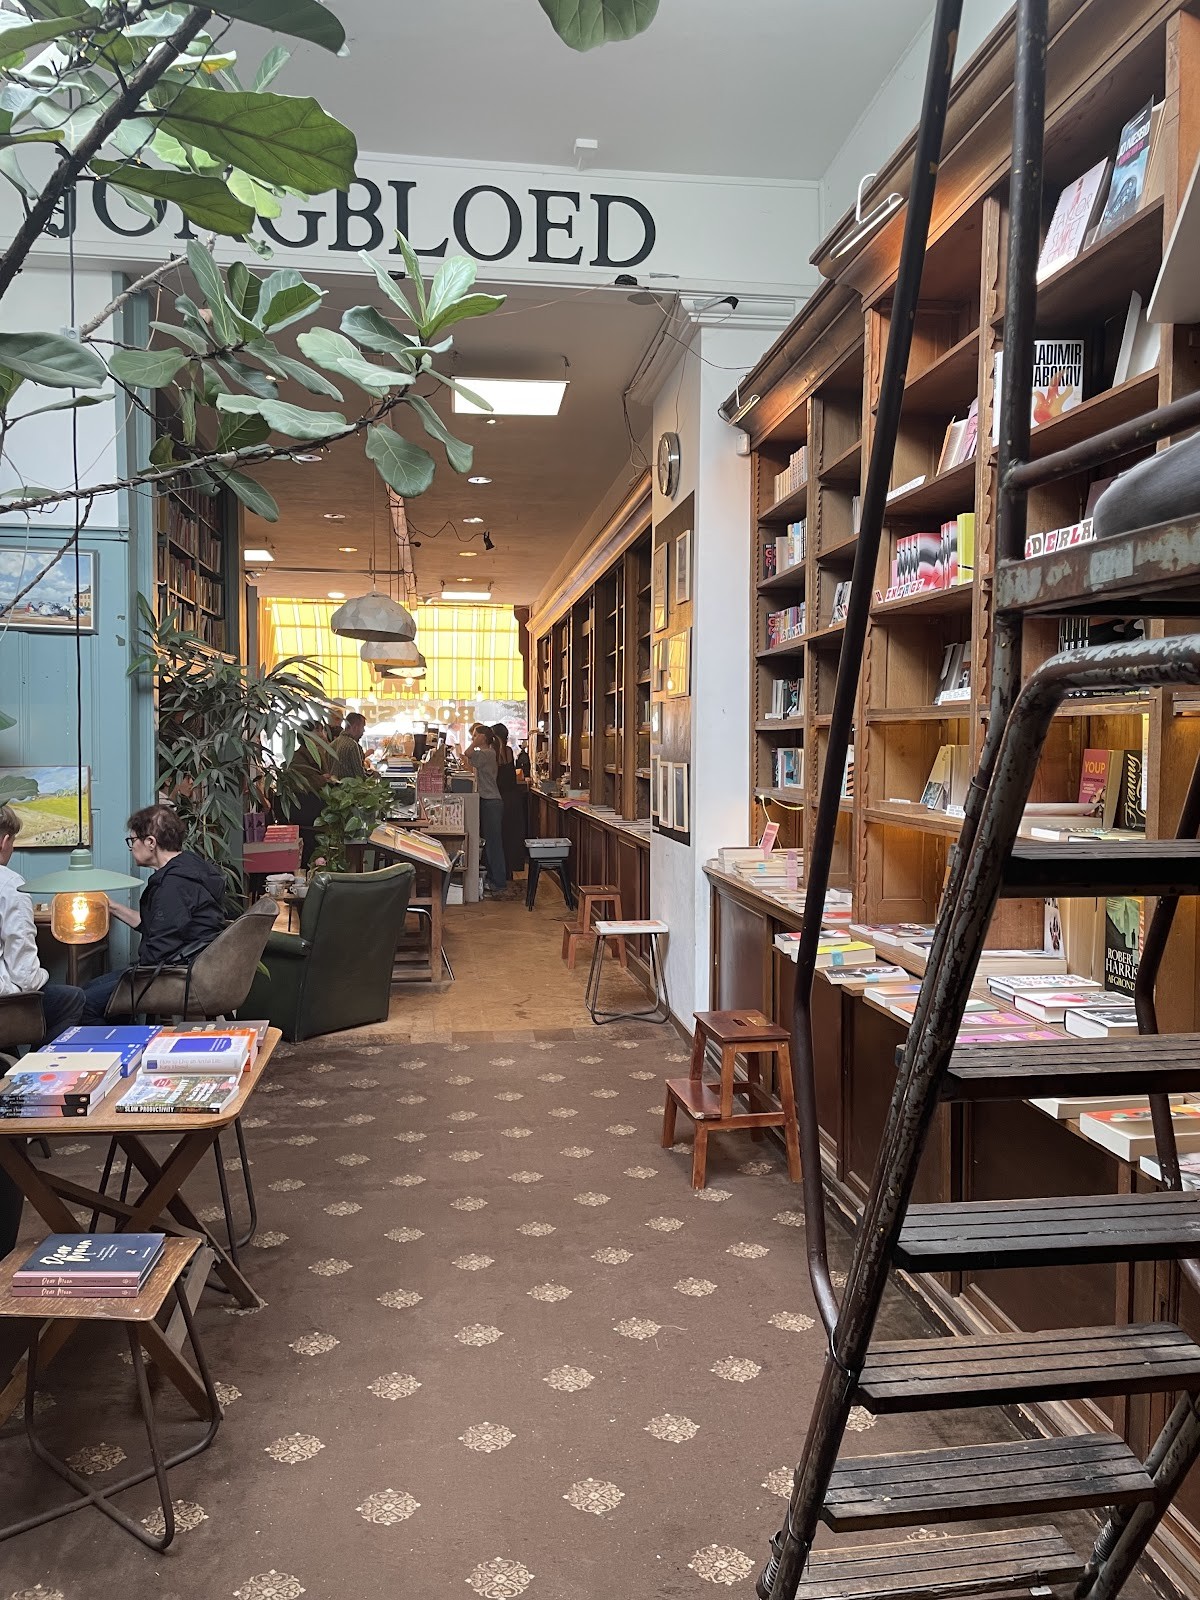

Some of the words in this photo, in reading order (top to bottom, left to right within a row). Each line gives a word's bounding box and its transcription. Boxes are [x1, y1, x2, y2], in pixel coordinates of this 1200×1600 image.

[1034, 344, 1082, 365] LADIMIR
[1034, 366, 1082, 387] ABOKOV
[1084, 761, 1106, 774] YOUP
[1124, 753, 1141, 828] Franny
[1106, 958, 1138, 980] HARRIS
[1107, 974, 1136, 991] AFGROND
[39, 1245, 72, 1265] Dear
[41, 1277, 55, 1286] Dear
[41, 1287, 55, 1296] Dear
